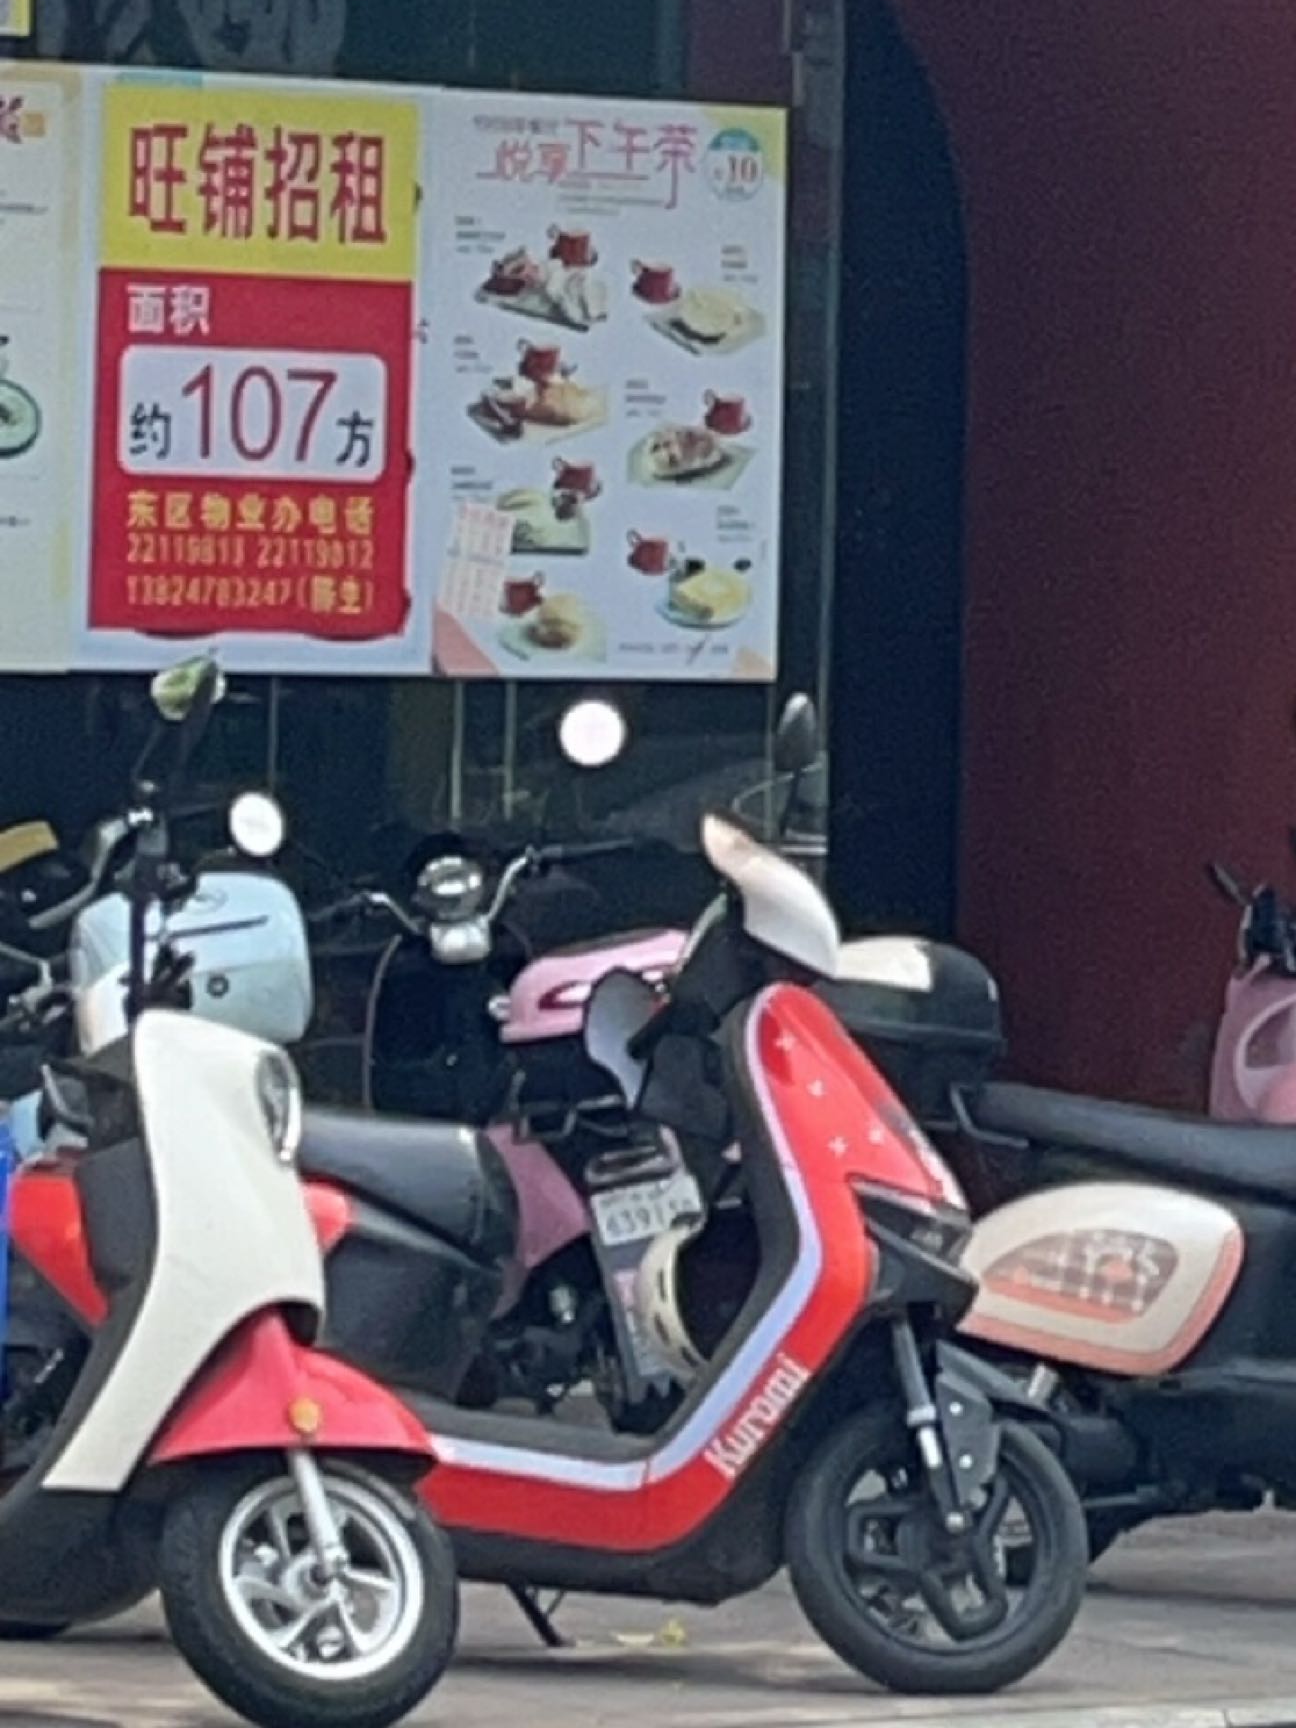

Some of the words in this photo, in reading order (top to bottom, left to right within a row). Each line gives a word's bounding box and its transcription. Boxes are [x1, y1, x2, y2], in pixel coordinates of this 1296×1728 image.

[128, 123, 387, 243] 旺铺招租
[126, 284, 210, 336] 面积
[127, 489, 375, 536] 东区物业办电话
[703, 1352, 811, 1479] Kuromi
